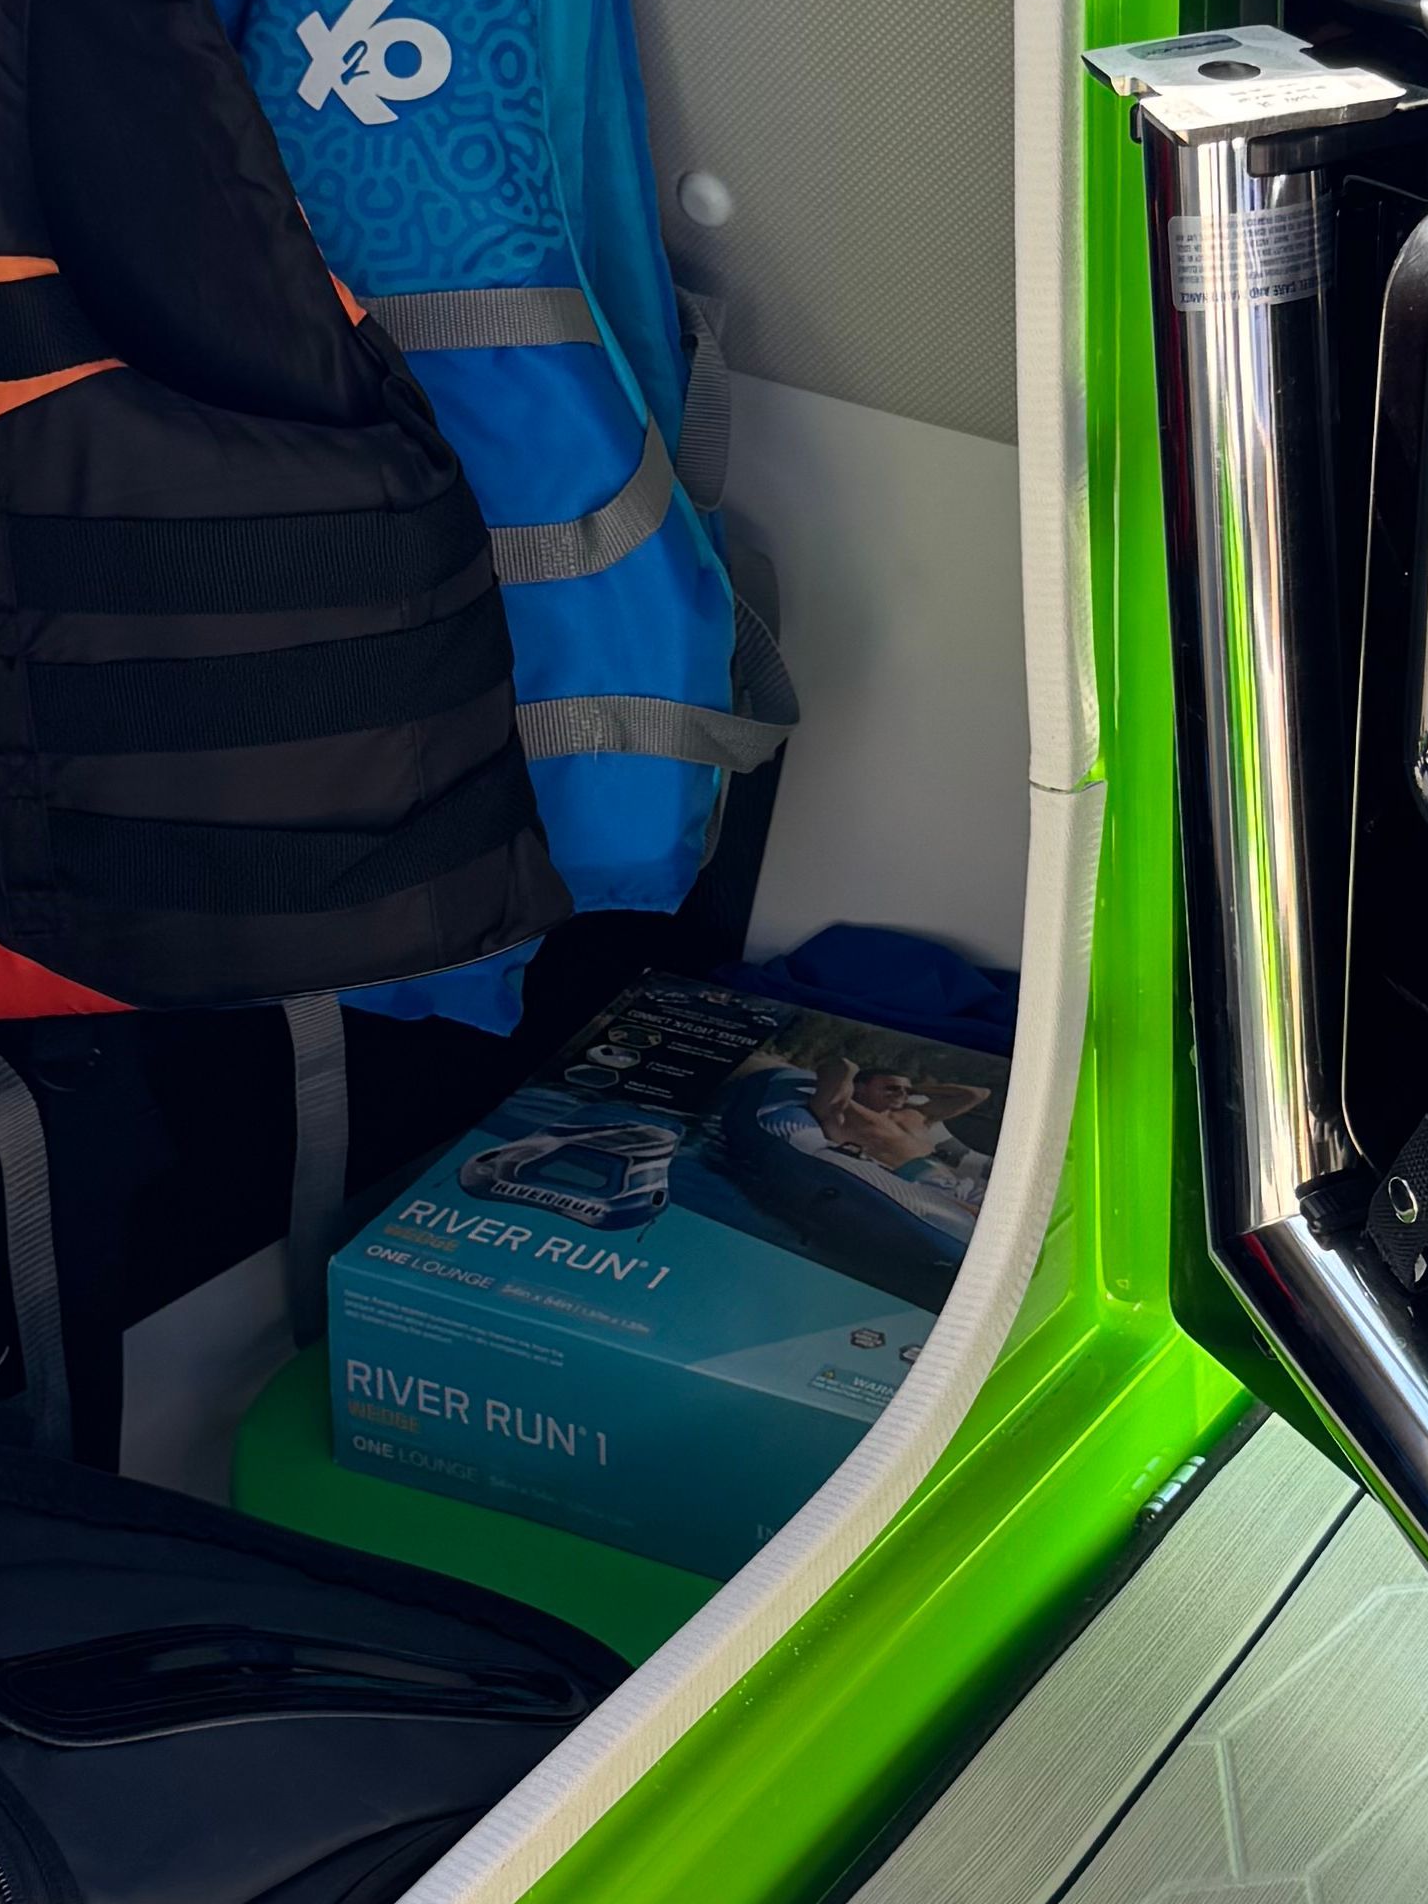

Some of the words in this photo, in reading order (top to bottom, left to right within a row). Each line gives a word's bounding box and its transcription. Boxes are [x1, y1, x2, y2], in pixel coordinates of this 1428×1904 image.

[397, 1199, 534, 1253] RIVER
[366, 1244, 412, 1267] ONE
[411, 1256, 495, 1291] LOUNGE
[345, 1358, 471, 1425] RIVER
[352, 1434, 395, 1460] ONE
[398, 1446, 479, 1484] LOUNGE
